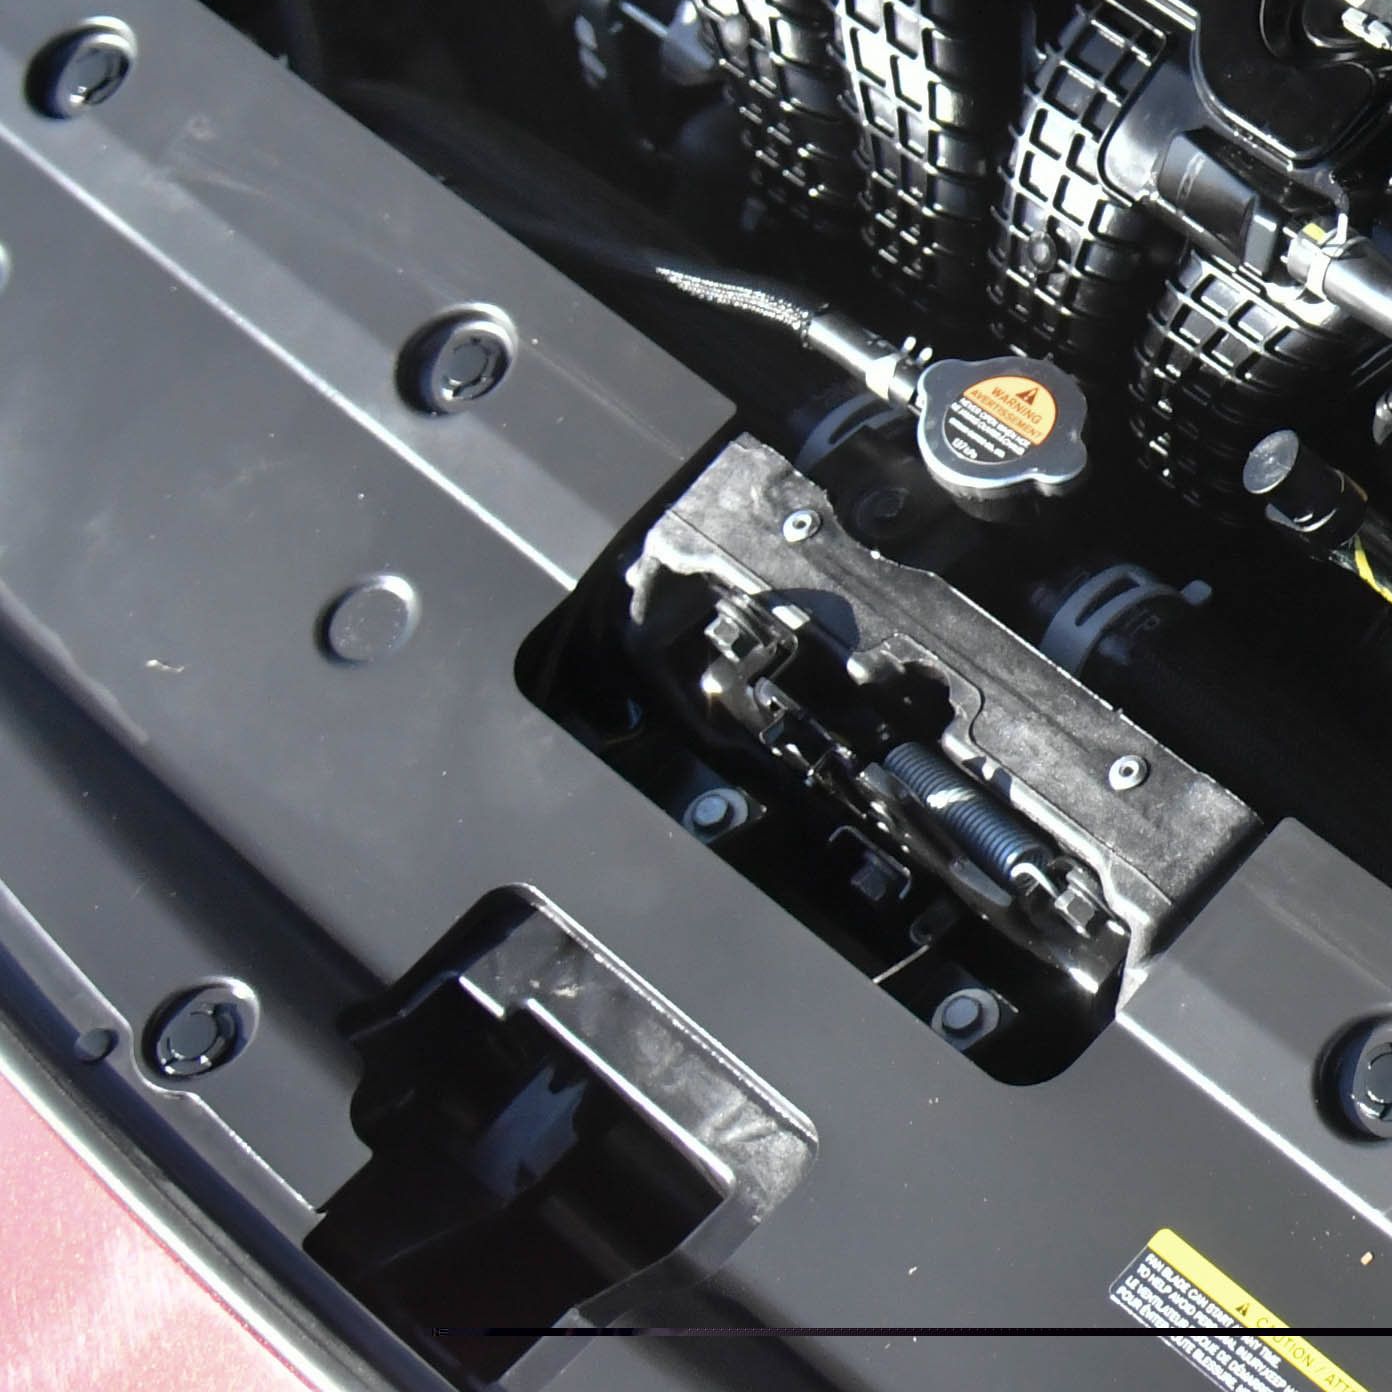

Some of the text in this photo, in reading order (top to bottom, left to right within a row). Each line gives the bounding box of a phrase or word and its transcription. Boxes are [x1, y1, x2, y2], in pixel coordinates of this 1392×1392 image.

[970, 389, 1042, 437] AVERTISSEMENT
[992, 387, 1042, 424] WARNING
[1125, 1275, 1140, 1290] LE
[1137, 1264, 1151, 1278] TO
[1148, 1274, 1172, 1293] HELP
[1168, 1291, 1196, 1315] AVOID
[1161, 1267, 1191, 1294] BLADE
[1188, 1289, 1208, 1308] CAN
